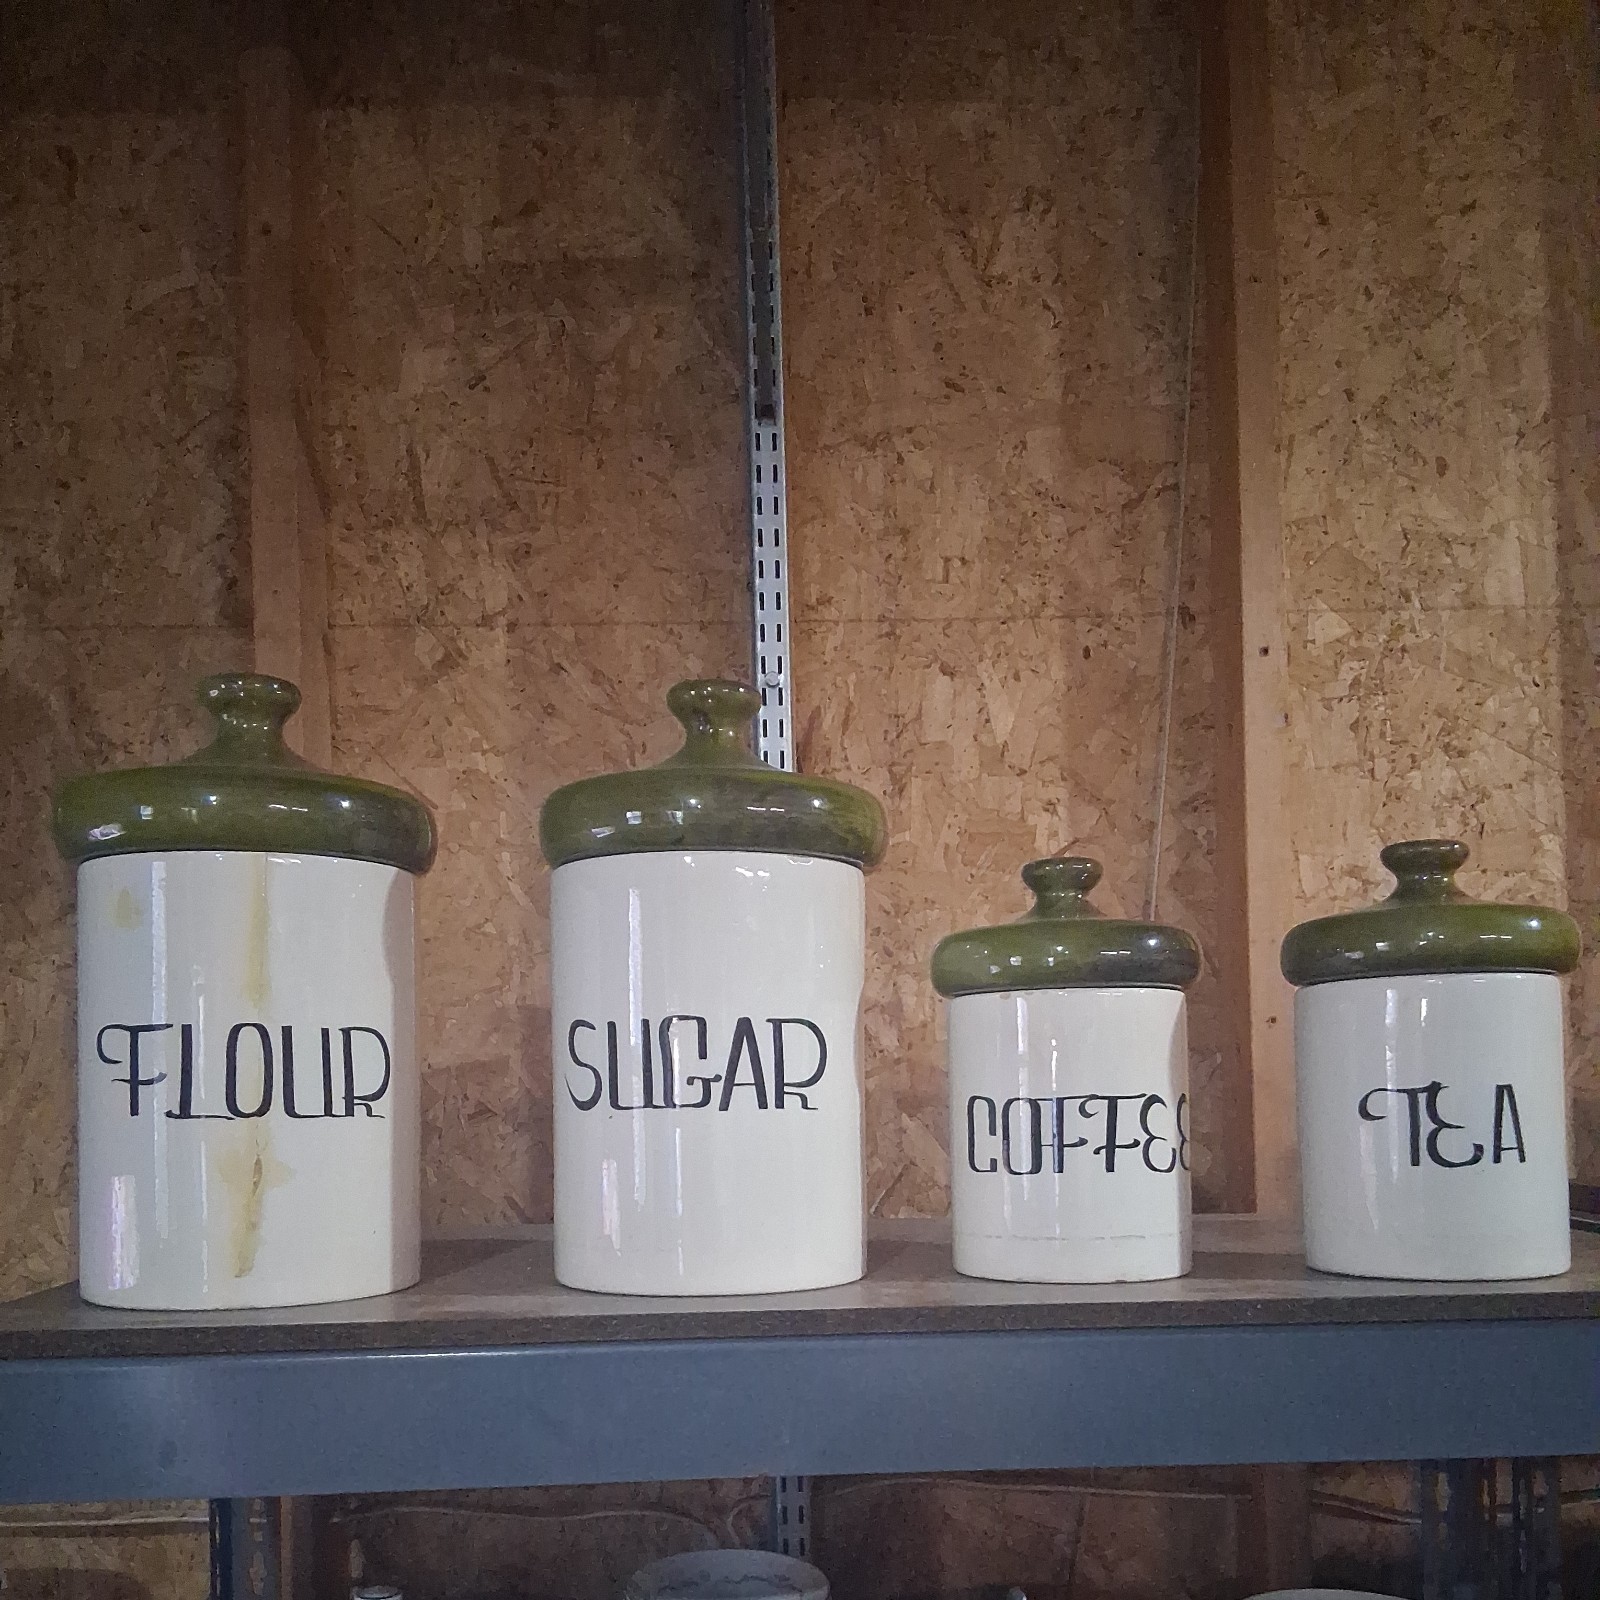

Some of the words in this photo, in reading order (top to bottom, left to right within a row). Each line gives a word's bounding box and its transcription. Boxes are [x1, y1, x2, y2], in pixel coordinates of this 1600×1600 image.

[96, 1022, 391, 1120] FLOUR
[564, 1014, 828, 1112] SUGAR
[1357, 1080, 1526, 1168] TEA
